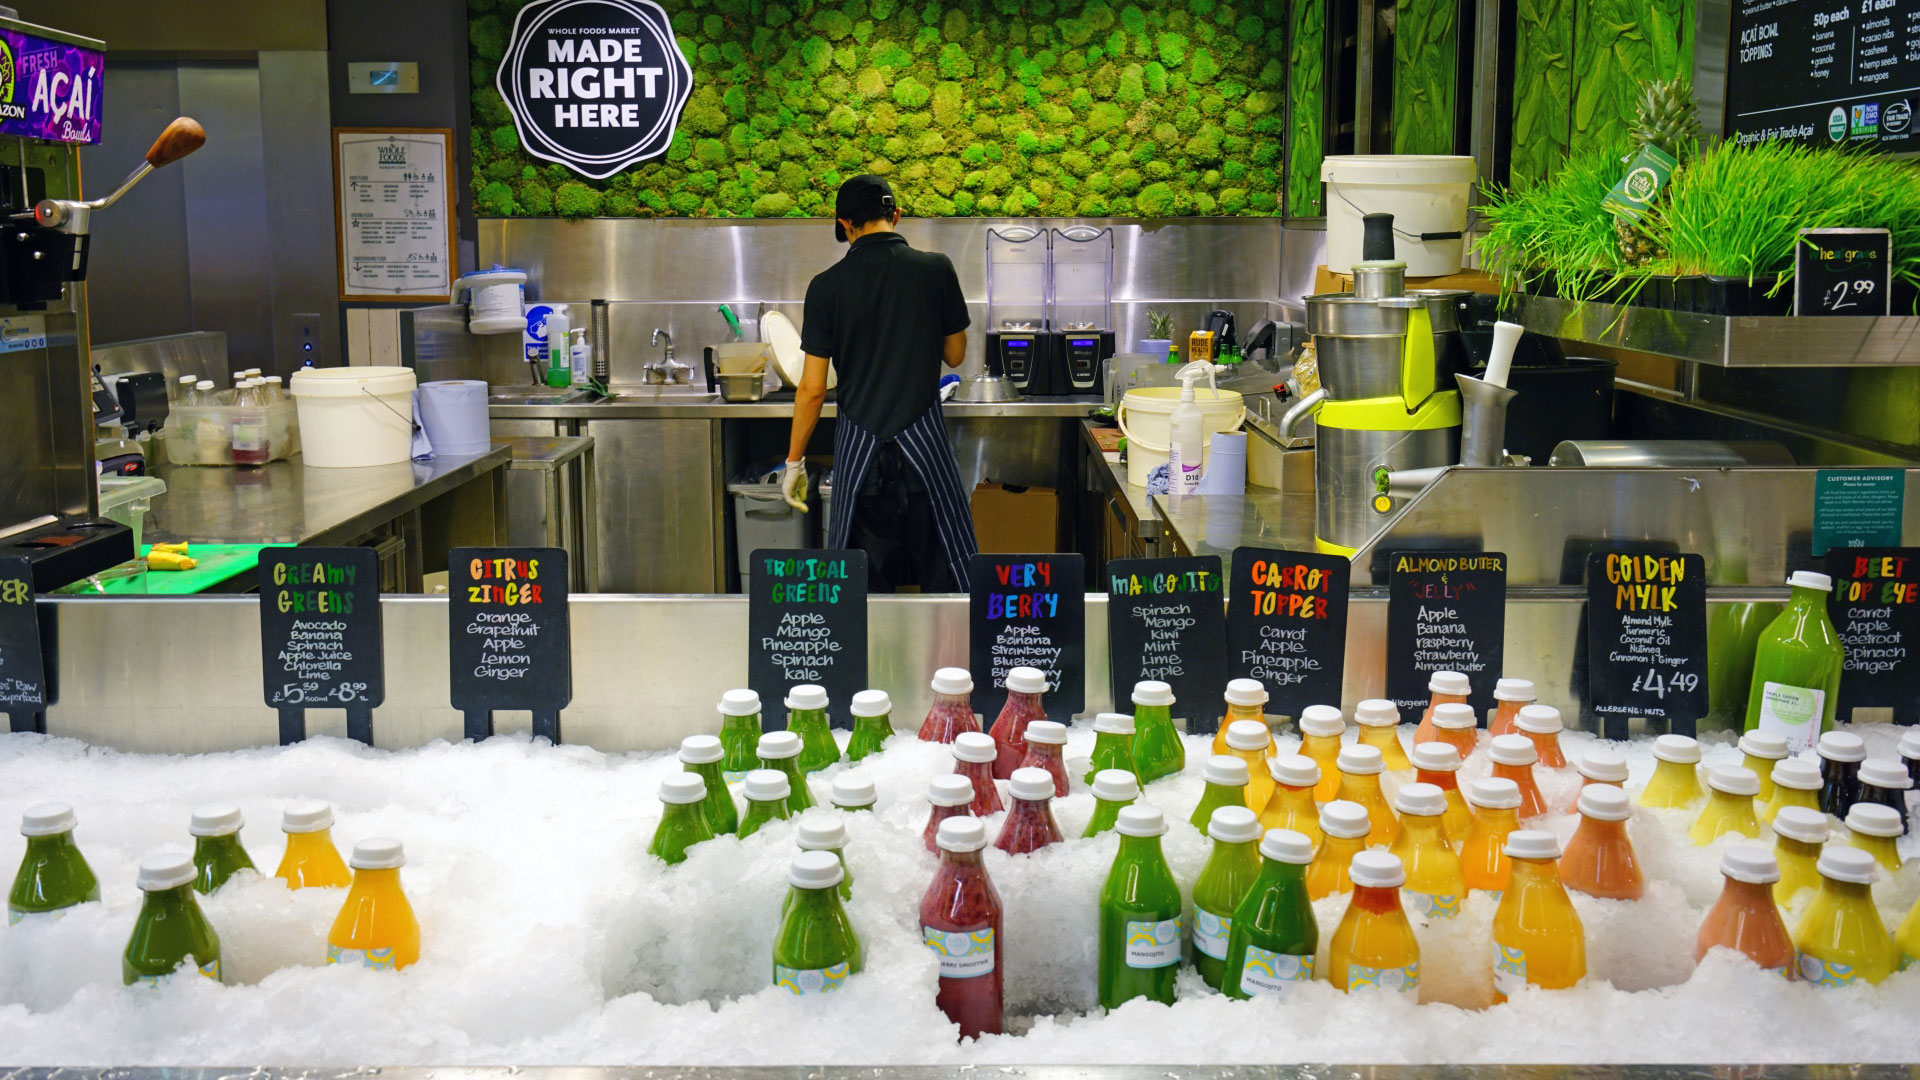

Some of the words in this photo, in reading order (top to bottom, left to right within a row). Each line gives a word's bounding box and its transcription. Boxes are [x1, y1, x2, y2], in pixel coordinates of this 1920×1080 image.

[1862, 0, 1872, 13] £1
[1874, 0, 1896, 10] each
[1813, 12, 1829, 28] 50p
[1830, 6, 1849, 22] each
[1866, 16, 1890, 30] almonds
[1740, 24, 1758, 48] AÇAÍ
[1759, 22, 1779, 40] BOWL
[1816, 30, 1834, 40] banana
[1865, 33, 1881, 43] cacao
[1882, 28, 1895, 39] nibs
[547, 39, 642, 63] MADE
[1740, 43, 1773, 64] TOPPINGS
[1815, 42, 1835, 53] coconut
[1864, 45, 1888, 56] cashews
[22, 51, 58, 74] FRESH
[1815, 53, 1833, 68] granola
[1864, 60, 1880, 70] hemp
[1881, 54, 1898, 66] seeds
[1814, 69, 1830, 78] honey
[1863, 72, 1889, 83] mangoes
[529, 67, 663, 99] RIGHT
[32, 66, 96, 124] AÇAÍ
[554, 104, 640, 128] HERE
[1866, 112, 1878, 120] GMO
[62, 121, 92, 142] Bowls
[1780, 125, 1797, 139] Trade
[377, 146, 406, 154] WHOLE
[1823, 280, 1875, 311] £2.99
[1191, 338, 1208, 347] RUDE
[764, 558, 848, 581] TROPICAL
[1396, 556, 1458, 573] ALMOND
[1460, 557, 1503, 572] BUTTER
[1606, 554, 1685, 585] GOLDEN
[1852, 555, 1909, 579] BEET
[995, 561, 1051, 587] VERY
[1251, 560, 1333, 593] CARROT
[0, 578, 29, 605] ER
[1616, 584, 1678, 612] MYLK
[1836, 578, 1873, 602] POP
[1881, 581, 1918, 604] EYE
[986, 592, 1058, 620] BERRY
[1132, 604, 1190, 620] Spinach
[1250, 590, 1328, 620] TOPPER
[1847, 606, 1893, 619] Carrot
[781, 612, 825, 627] Apple
[1417, 605, 1458, 623] Apple
[1622, 615, 1652, 625] Almond
[292, 619, 347, 630] Avocado
[466, 622, 541, 638] Grapefruit
[1004, 625, 1041, 637] Apple
[1145, 617, 1196, 630] Mango
[1417, 623, 1466, 635] Banana
[1624, 625, 1666, 636] Turmeric
[1846, 620, 1890, 635] Apple
[290, 631, 343, 640] Banana
[777, 625, 831, 641] Mango
[996, 635, 1051, 645] Banana
[1151, 629, 1179, 640] Kiwi
[1260, 625, 1308, 641] Carrot
[1620, 635, 1654, 644] Coconut
[1656, 636, 1670, 645] Oil
[1838, 631, 1902, 645] Beetroot
[287, 641, 343, 651] Spinach
[483, 638, 526, 652] Apple
[762, 638, 842, 654] Pineapple
[1144, 640, 1181, 652] Mint
[1260, 639, 1307, 654] Apple
[1416, 636, 1474, 650] raspberry
[1630, 644, 1661, 656] Nutmeg
[278, 651, 315, 662] Apple
[317, 651, 352, 660] Juice
[481, 652, 530, 664] Lemon
[991, 645, 1061, 658] Strawberry
[1142, 653, 1182, 665] Lime
[1844, 646, 1906, 660] Spinach
[284, 661, 342, 671] Chlorella
[771, 653, 833, 668] Spinach
[993, 657, 1057, 669] Blueberry
[1242, 650, 1322, 672] Pineapple
[1414, 662, 1454, 671] Almond
[1456, 662, 1486, 671] butter
[1609, 652, 1648, 663] Cinnamon
[1658, 656, 1688, 667] Ginger
[1843, 659, 1901, 674] Ginger
[299, 671, 331, 679] Lime
[474, 665, 529, 680] Ginger
[1140, 665, 1184, 680] Apple
[1250, 665, 1308, 686] Ginger
[1632, 668, 1698, 699] £4.49
[1595, 705, 1642, 715] ALLERGENS:
[1644, 708, 1665, 716] NUTS
[959, 959, 989, 968] SMOOTHIE
[1246, 976, 1282, 991] MANGOJITO
